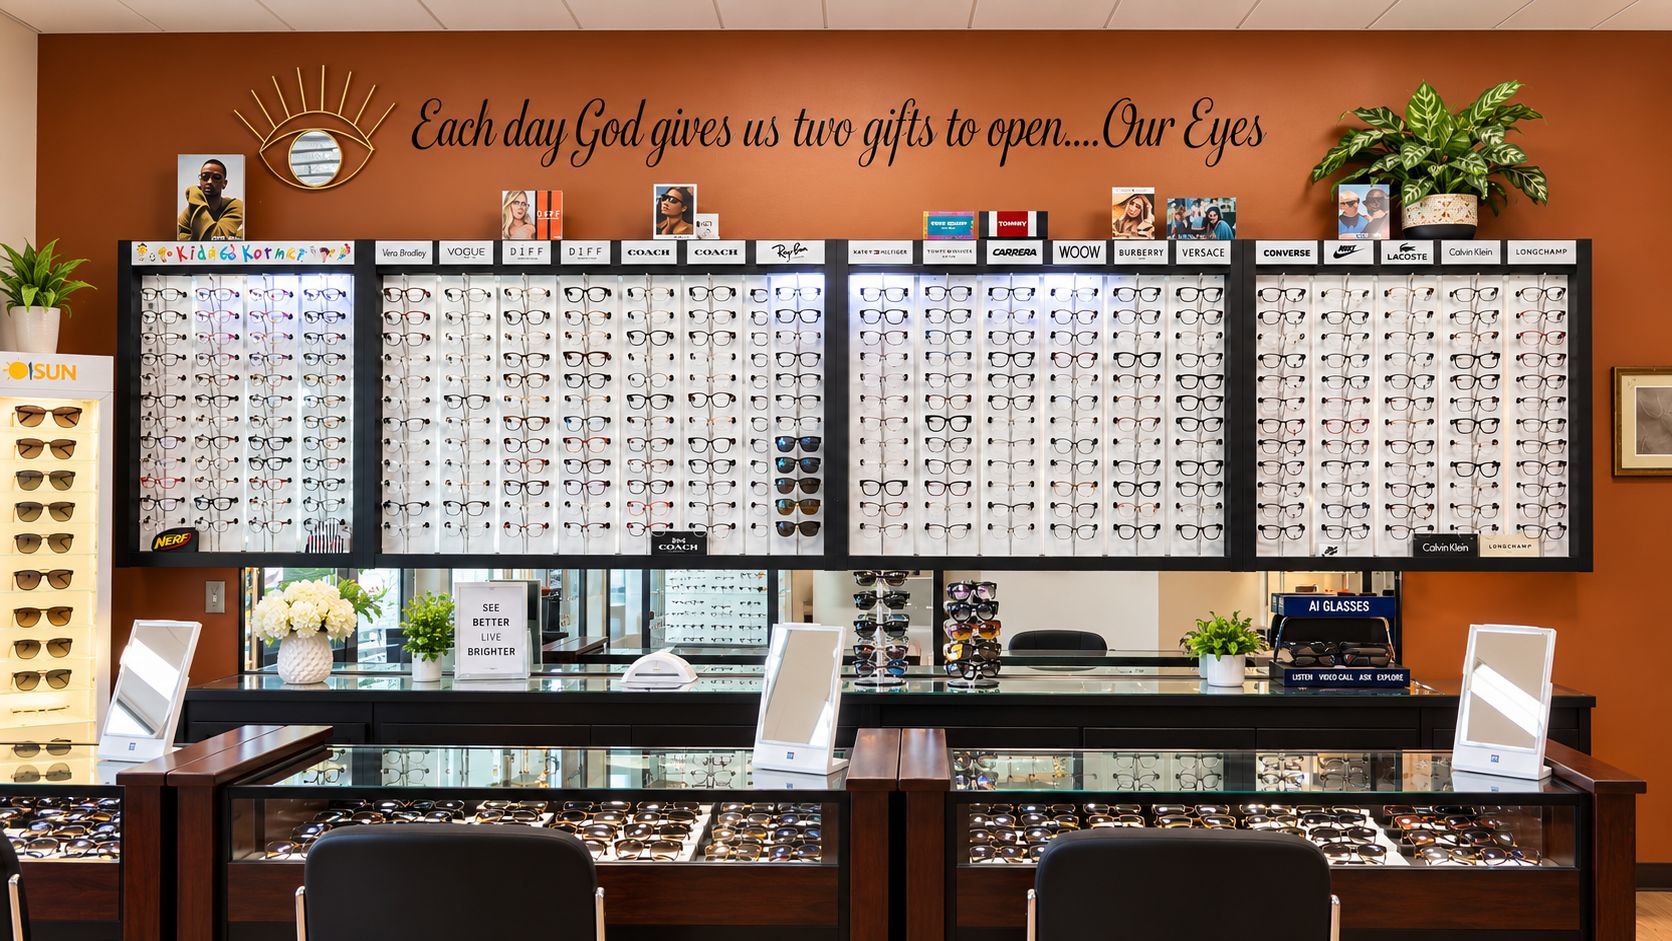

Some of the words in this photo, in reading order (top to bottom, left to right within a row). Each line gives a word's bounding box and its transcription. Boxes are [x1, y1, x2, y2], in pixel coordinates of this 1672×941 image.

[411, 98, 497, 150] Each
[503, 98, 568, 167] day
[571, 98, 646, 167] God
[646, 107, 731, 167] gives
[743, 116, 780, 147] us
[793, 108, 856, 147] two
[858, 98, 937, 167] gifts
[946, 108, 981, 147] to
[1184, 97, 1266, 167] Eyes
[382, 248, 398, 257] Vera
[400, 248, 427, 259] Bradley
[447, 247, 485, 256] VOGUE
[510, 247, 543, 256] DIFF
[569, 247, 602, 256] DIFF
[992, 248, 1037, 257] CARRERA
[1059, 245, 1101, 259] WOOW
[1119, 248, 1164, 256] BURBERRY
[1182, 248, 1224, 257] VERSACE
[1263, 249, 1311, 257] CONVERSE
[1449, 247, 1473, 257] Calvin
[1474, 247, 1492, 257] Klein
[1516, 248, 1567, 256] LONGCHAMP
[1387, 253, 1427, 261] LACOSTE
[33, 363, 77, 380] SUN
[154, 532, 189, 549] NERF
[1422, 542, 1449, 552] Calvin
[1450, 542, 1469, 552] Klein
[482, 603, 500, 612] SEE
[1308, 600, 1320, 611] AI
[1323, 600, 1370, 612] GLASSES
[472, 618, 510, 626] BETTER
[481, 633, 502, 641] LIVE
[467, 647, 516, 656] BRIGHTER
[1377, 673, 1404, 681] EXPLORE
